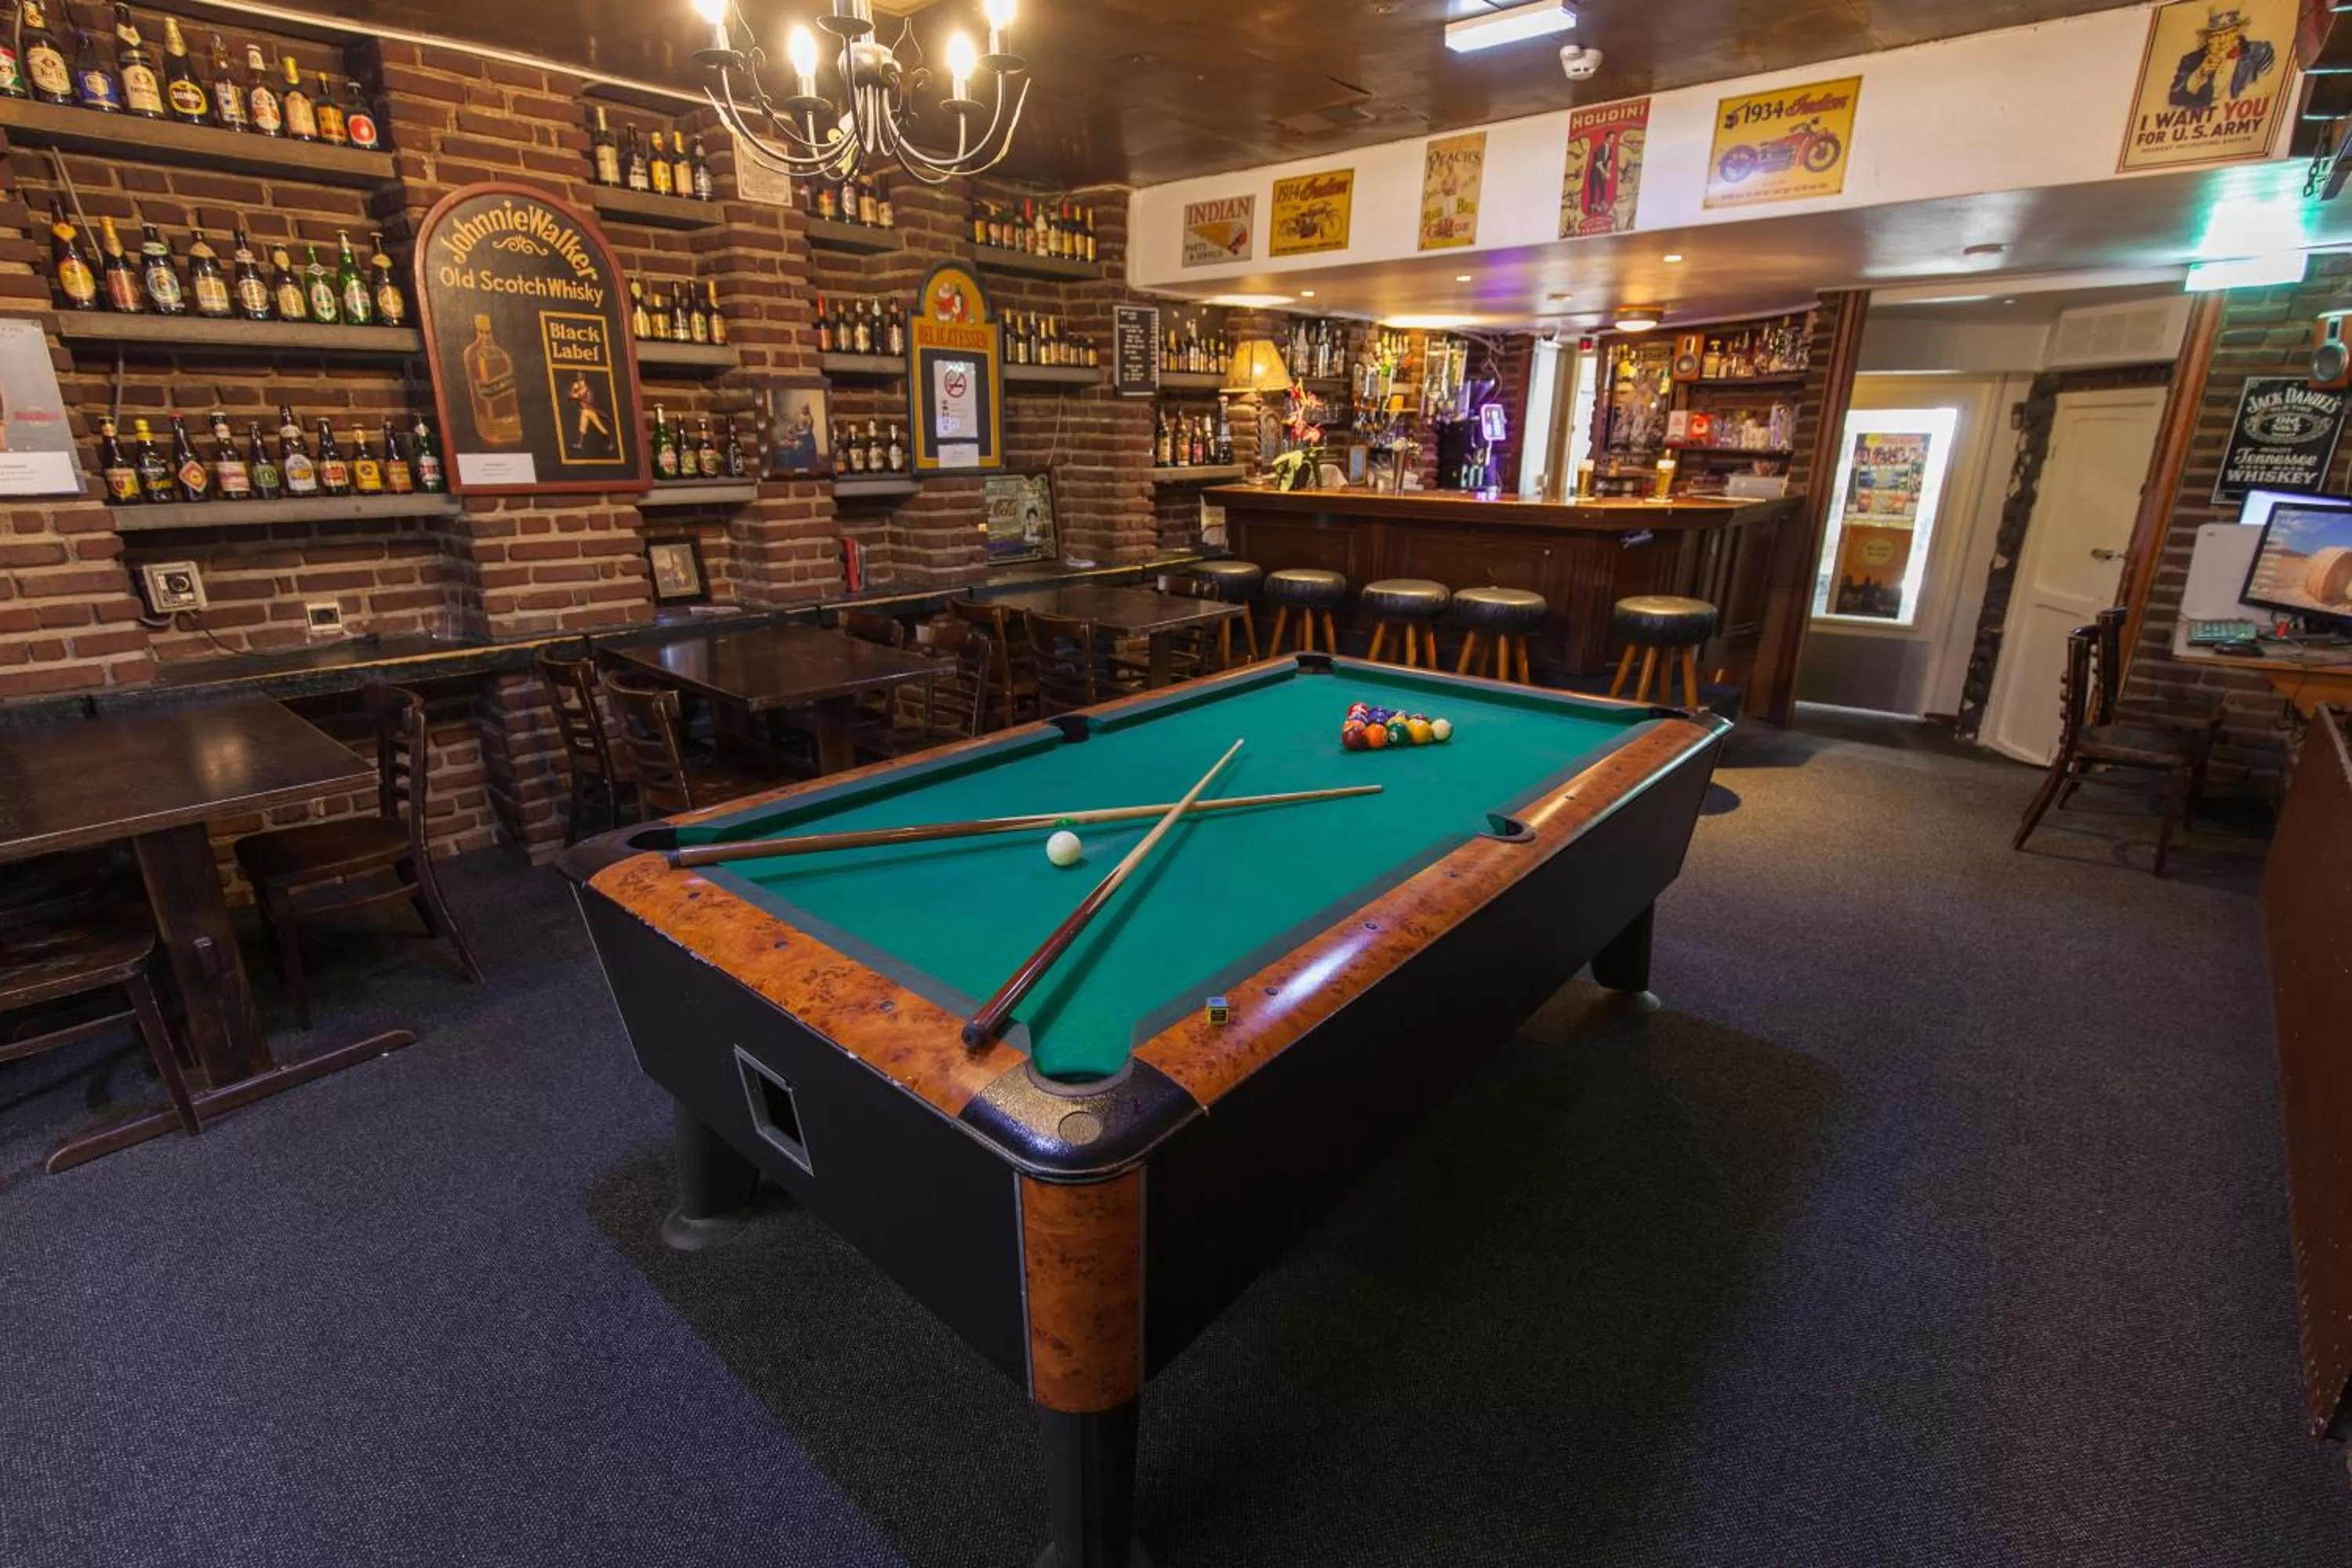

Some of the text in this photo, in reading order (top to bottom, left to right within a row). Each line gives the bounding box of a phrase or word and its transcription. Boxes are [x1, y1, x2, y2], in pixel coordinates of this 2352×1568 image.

[1571, 104, 1646, 130] HOUDINI
[1743, 100, 1784, 124] 1934
[2140, 97, 2270, 131] I WANT YOU
[2136, 132, 2167, 146] FOR
[2211, 118, 2265, 137] ARMY
[1188, 197, 1250, 226] INDIAN
[441, 199, 599, 281] Johnnie Walker
[439, 265, 604, 309] Old Scotch Whisky
[550, 321, 601, 343] Black
[919, 325, 989, 350] DELICATESSEN
[551, 340, 600, 362] Label
[2246, 391, 2284, 414] JACK
[2234, 447, 2318, 466] Tennessee
[2225, 469, 2319, 485] WHISKEY
